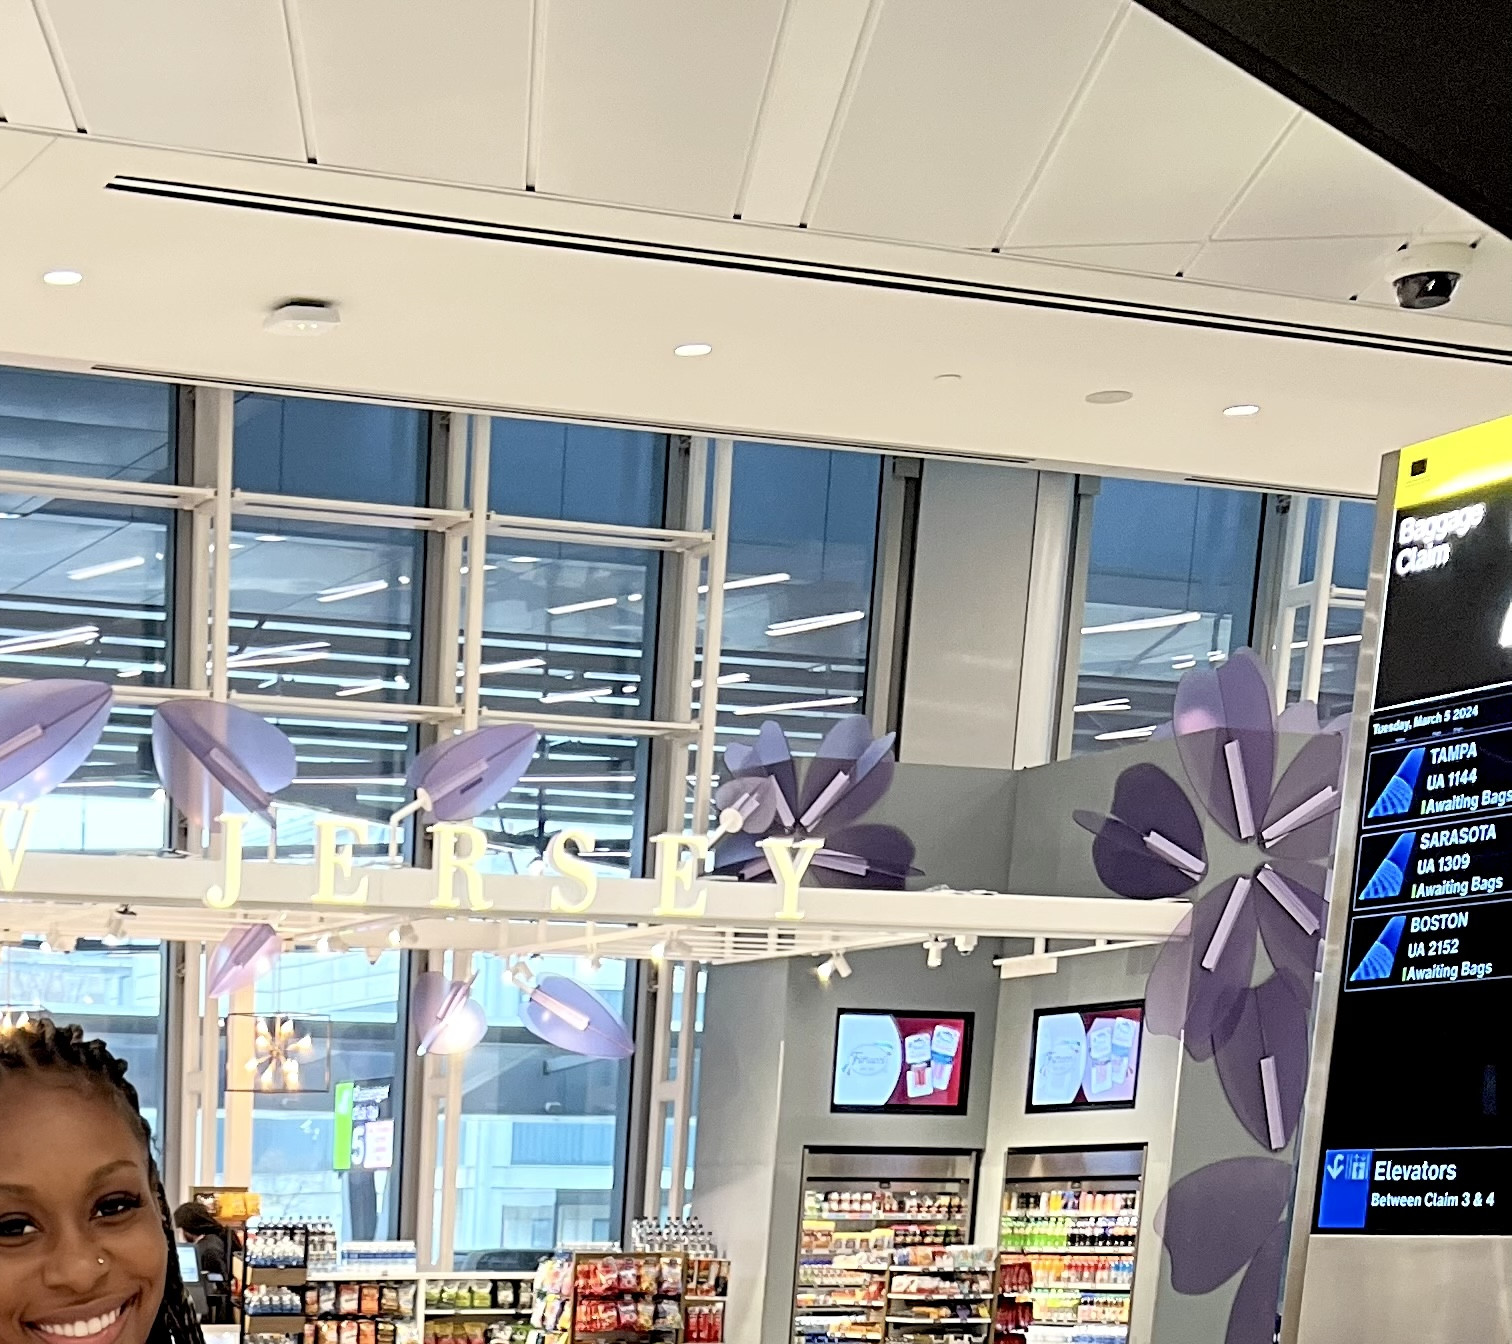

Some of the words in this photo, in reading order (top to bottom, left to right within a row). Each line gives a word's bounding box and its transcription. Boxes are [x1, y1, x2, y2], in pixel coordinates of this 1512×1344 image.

[1399, 502, 1486, 546] Baggage
[1395, 542, 1451, 576] Claim
[1372, 719, 1413, 735] Tuesday,
[1414, 712, 1442, 728] March
[1443, 709, 1452, 722] 5
[1452, 705, 1479, 720] 2024
[1430, 742, 1477, 764] TAMPA
[1426, 773, 1445, 791] UA
[1448, 768, 1477, 787] 1144
[1425, 794, 1479, 815] Awaiting
[1419, 823, 1497, 850] SARASOTA
[204, 813, 825, 920] JERSEY
[1417, 858, 1435, 875] UA
[1438, 852, 1471, 872] 1309
[1416, 878, 1469, 899] Awaiting
[1470, 876, 1504, 893] Bags
[1410, 911, 1469, 933] BOSTON
[1407, 941, 1425, 958] UA
[1427, 938, 1459, 956] 2152
[1405, 963, 1459, 981] Awaiting
[1460, 961, 1493, 980] Bags
[1374, 1160, 1457, 1181] Elevators
[1371, 1192, 1422, 1207] Between
[1424, 1192, 1459, 1207] Claim
[1461, 1191, 1471, 1207] 3
[1472, 1191, 1483, 1207] &
[1485, 1191, 1495, 1207] 4
